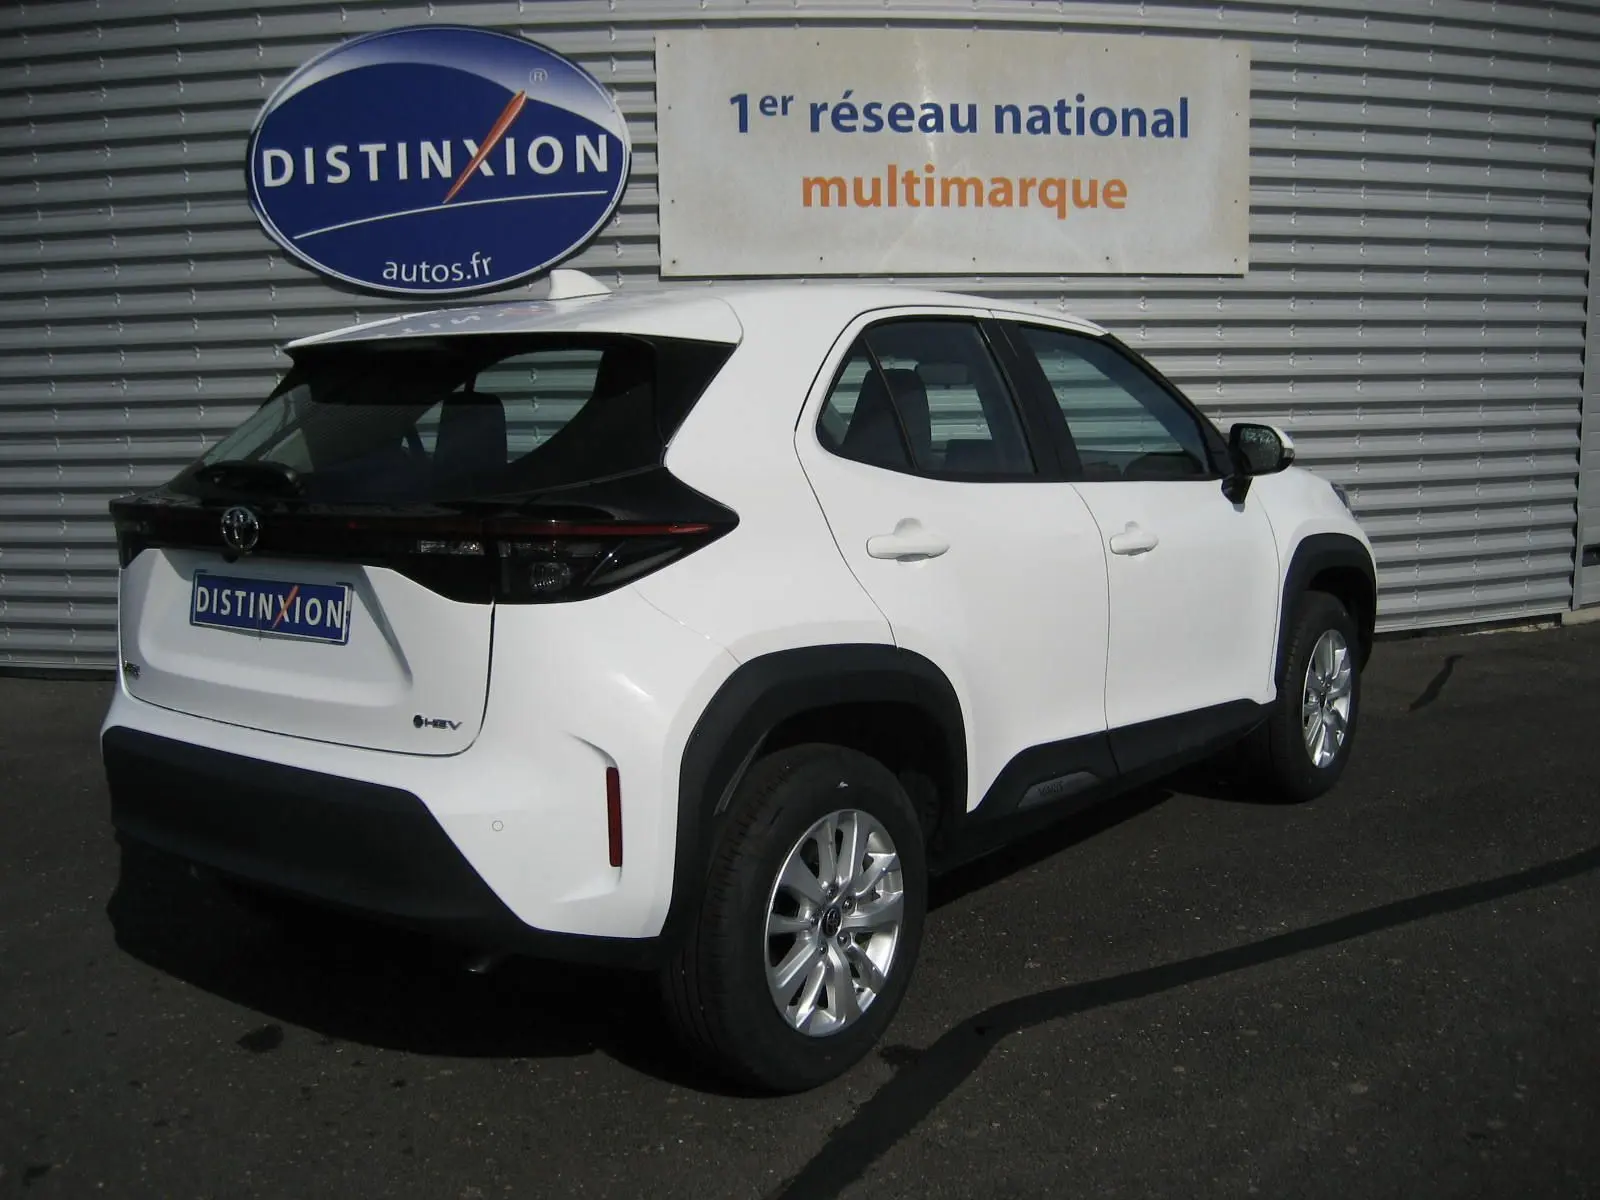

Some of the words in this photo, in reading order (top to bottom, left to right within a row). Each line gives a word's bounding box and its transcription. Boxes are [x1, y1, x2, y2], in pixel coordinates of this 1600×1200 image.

[729, 93, 794, 134] 1er
[808, 90, 978, 134] réseau
[993, 95, 1190, 138] national
[262, 133, 608, 188] DISTINXION
[801, 164, 1128, 219] multimarque
[382, 251, 492, 283] autos.fr
[196, 586, 342, 629] DISTINXION
